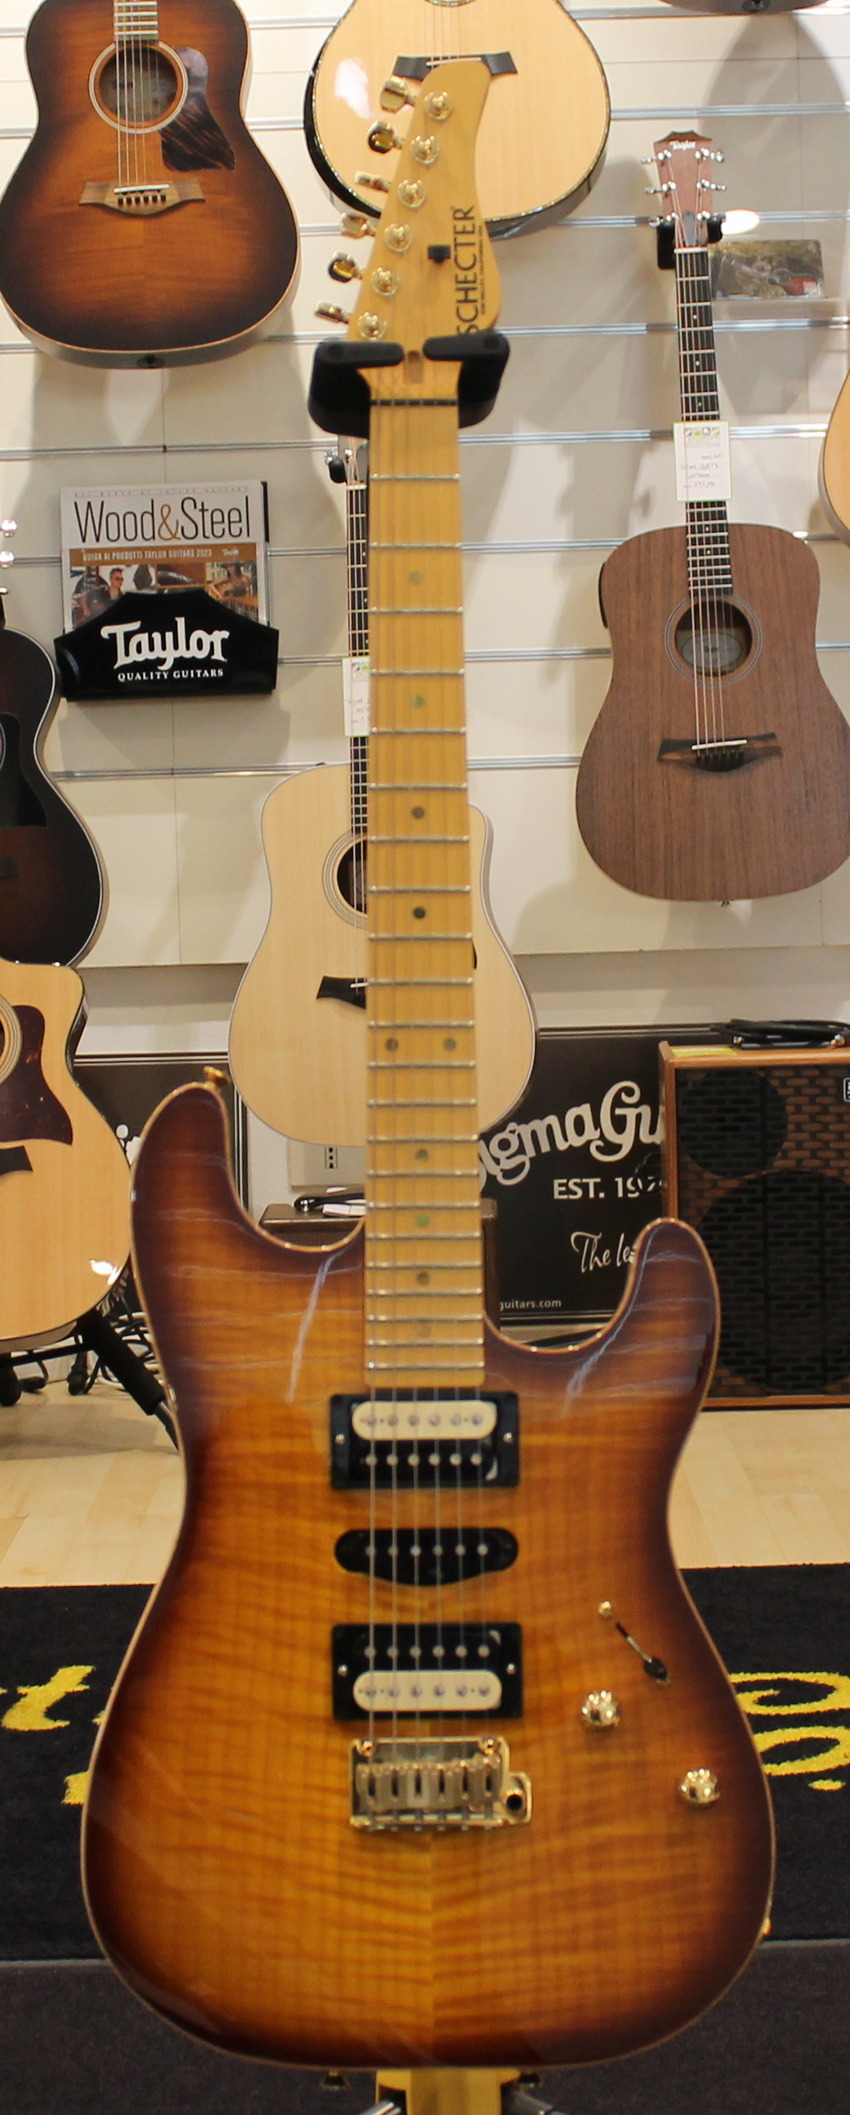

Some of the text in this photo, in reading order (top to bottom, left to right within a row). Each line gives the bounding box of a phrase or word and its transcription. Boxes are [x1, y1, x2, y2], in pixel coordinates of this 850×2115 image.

[453, 205, 479, 335] SCHECTER
[74, 496, 249, 543] Wood&Steel
[112, 551, 142, 560] PRODOTTI
[145, 550, 166, 560] TAYLOR
[168, 549, 194, 559] GUITARS
[100, 617, 230, 670] Taylor
[117, 668, 224, 683] QUALITY GUITARS
[553, 1178, 605, 1199] EST.
[571, 1232, 611, 1273] The
